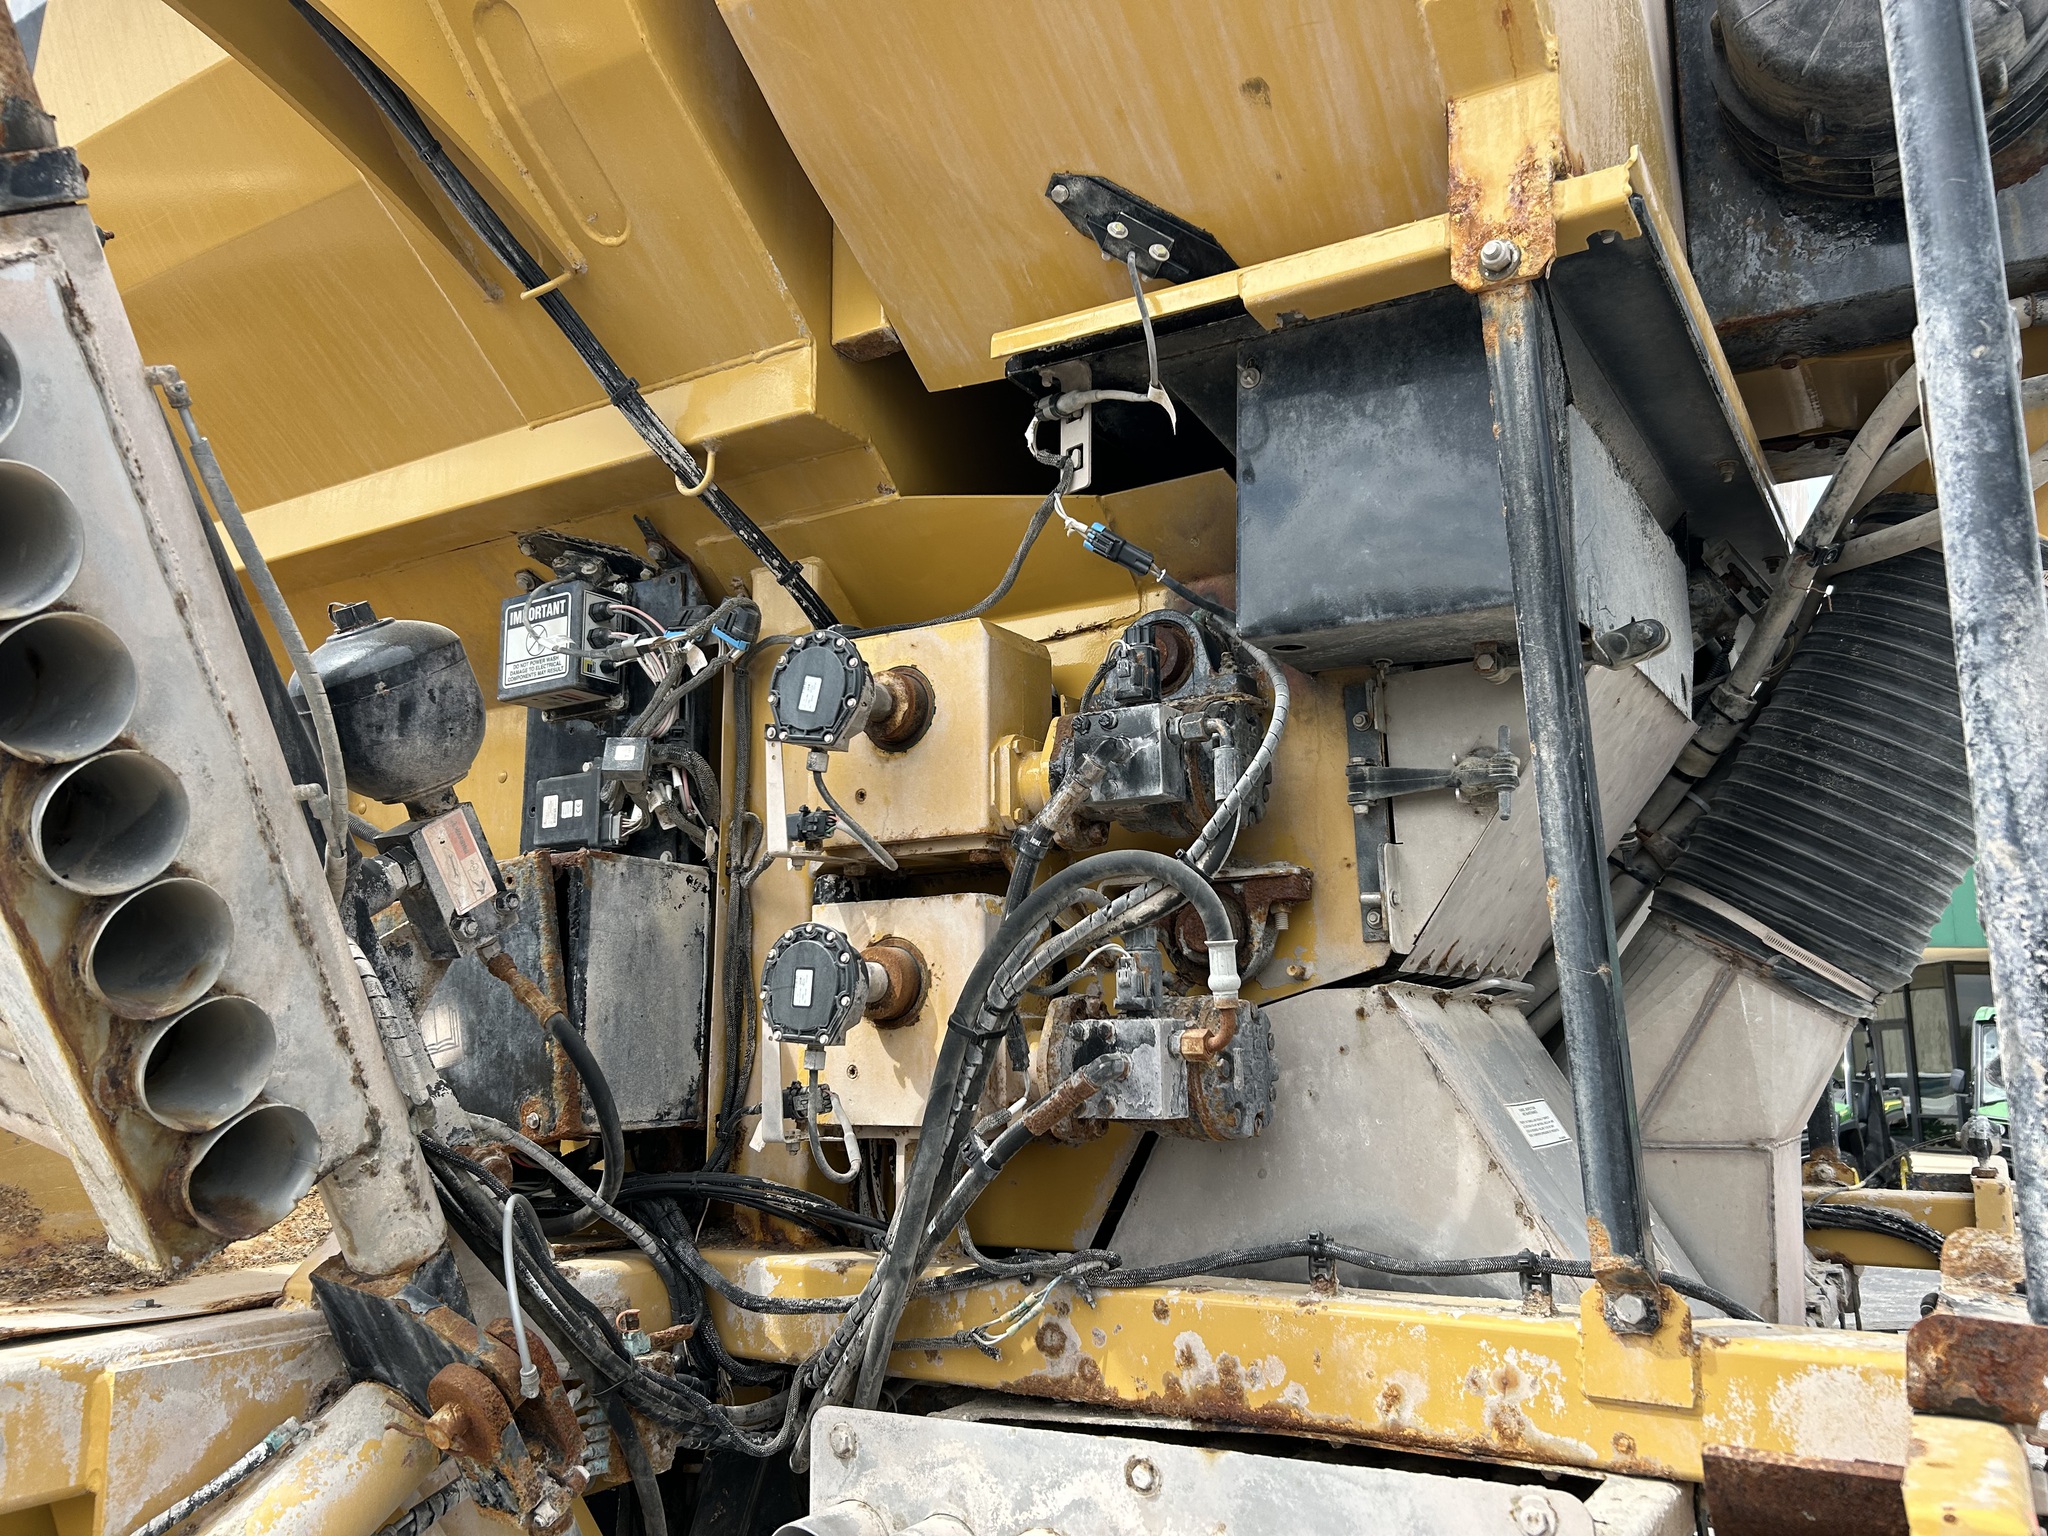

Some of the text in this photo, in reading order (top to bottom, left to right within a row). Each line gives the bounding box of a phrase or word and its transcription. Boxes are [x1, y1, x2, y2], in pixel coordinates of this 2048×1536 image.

[509, 599, 566, 626] IMORTANT
[510, 668, 528, 676] DAMAGE
[536, 661, 561, 671] ELECTRICAL
[508, 672, 536, 682] COMPONENTS
